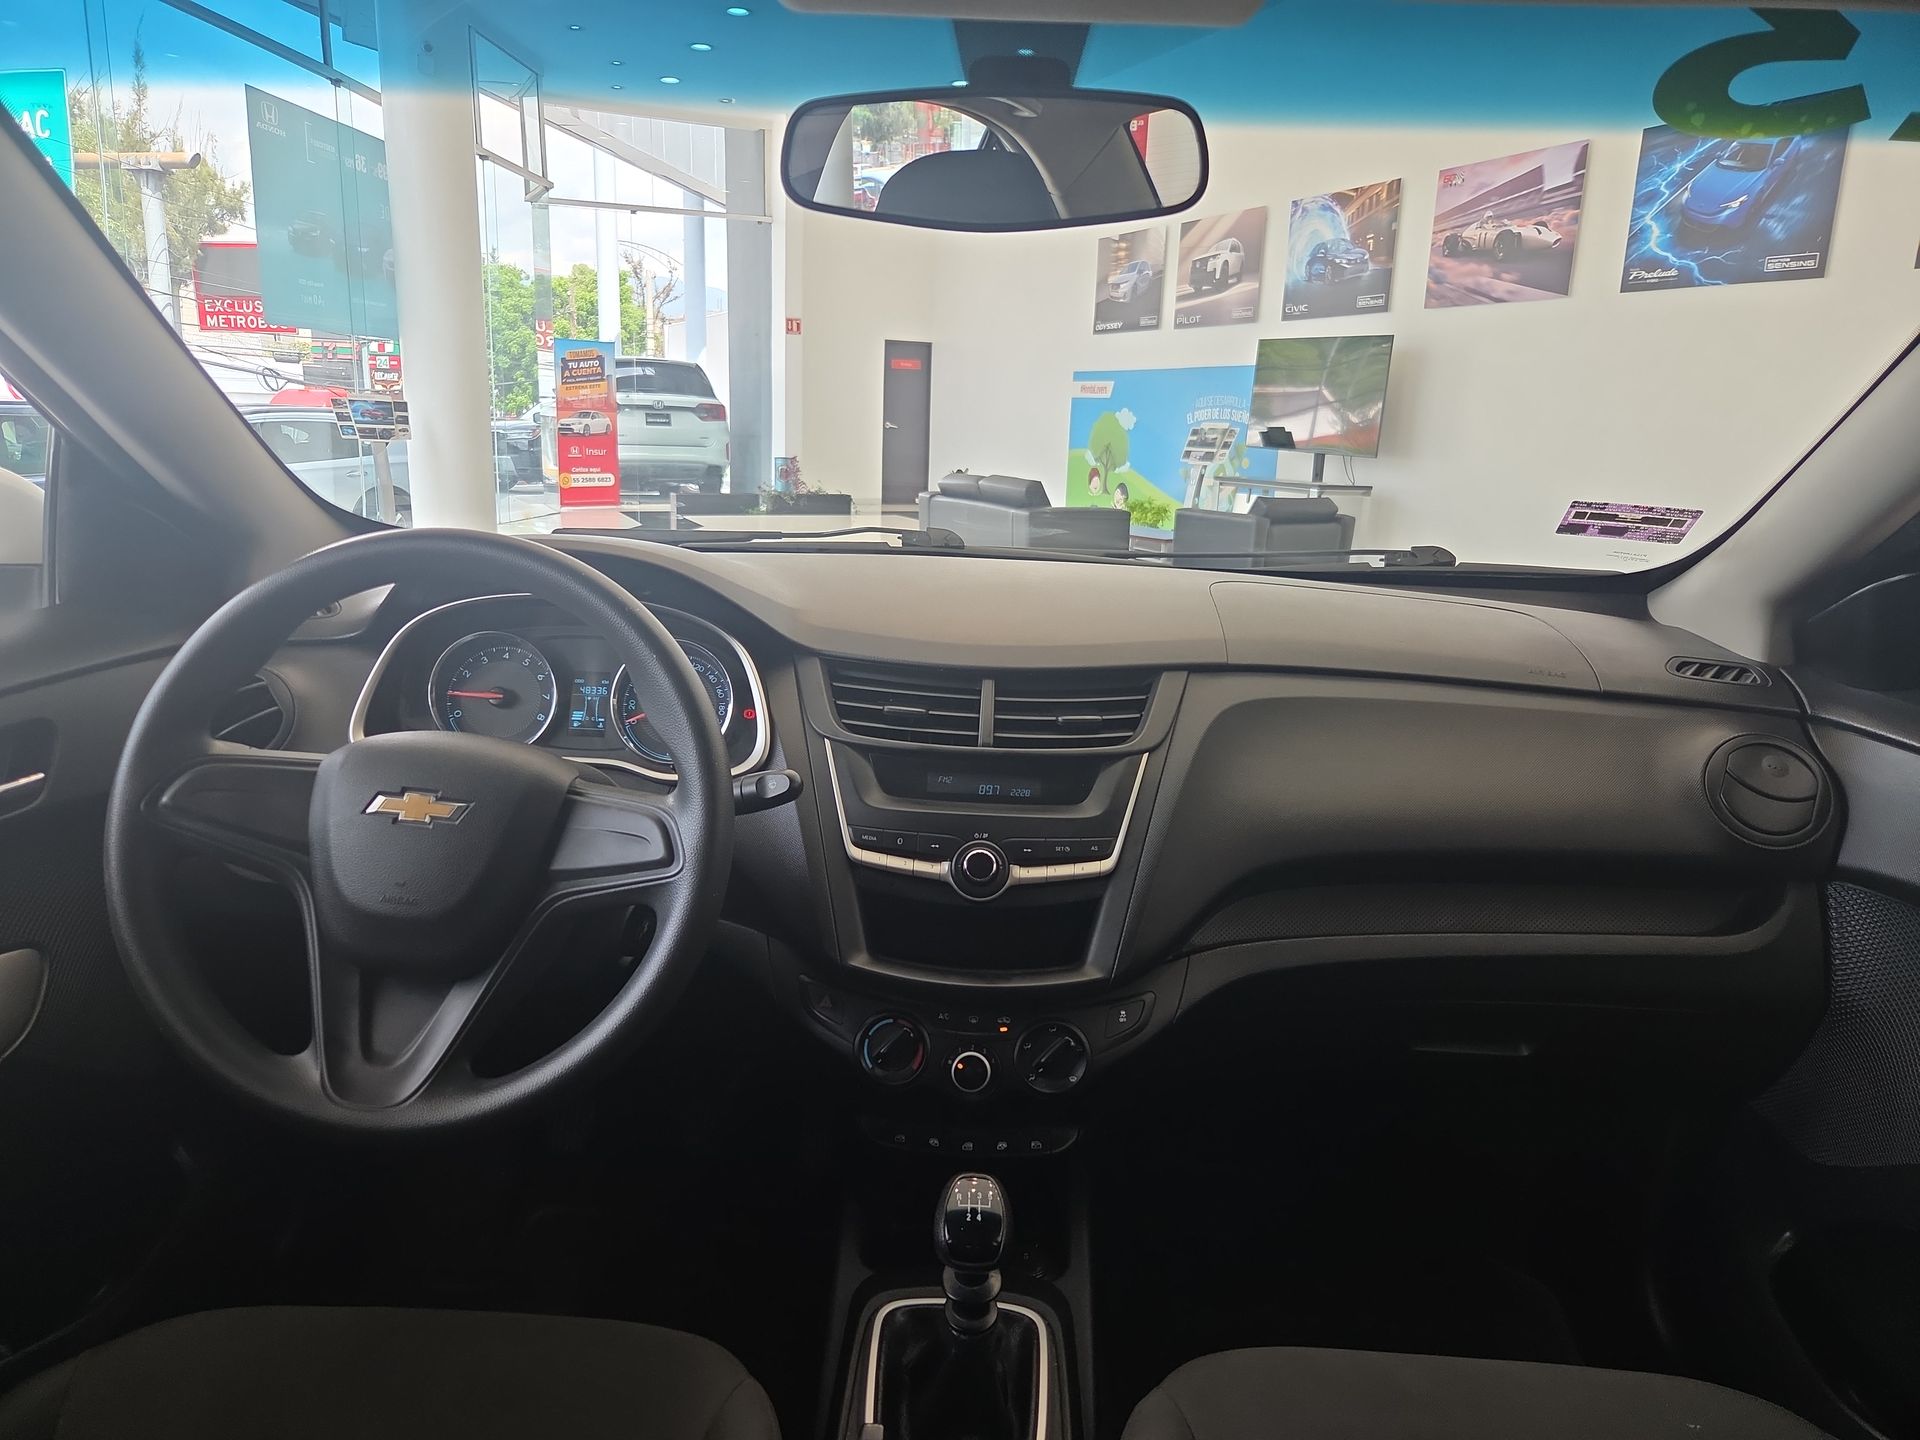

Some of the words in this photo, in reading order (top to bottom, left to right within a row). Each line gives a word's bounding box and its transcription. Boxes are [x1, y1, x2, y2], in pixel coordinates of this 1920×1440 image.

[1767, 260, 1815, 270] SENSING
[1628, 268, 1680, 281] Prelude
[204, 299, 264, 313] EXCLUS
[1285, 304, 1309, 313] CIVIC
[1176, 315, 1201, 325] PILOT
[1095, 322, 1124, 331] ODYSSEY
[377, 358, 389, 368] 24
[579, 360, 600, 368] AUTO
[563, 371, 571, 379] A
[571, 367, 603, 376] CUENTA
[1187, 413, 1193, 425] EL
[1194, 408, 1211, 422] PODER
[1212, 408, 1220, 420] DE
[1220, 408, 1231, 420] LOS
[1231, 409, 1250, 425] SUEÑO
[585, 447, 608, 456] Insur
[480, 655, 489, 665] 3
[502, 652, 510, 660] 4
[522, 658, 531, 667] 5
[462, 669, 472, 679] 2
[537, 673, 546, 681] 6
[705, 671, 718, 684] 140
[580, 686, 608, 695] 48336
[715, 685, 725, 698] 160
[628, 699, 636, 710] 20
[718, 702, 726, 716] 180
[453, 709, 462, 718] 0
[536, 713, 546, 721] 8
[937, 775, 953, 784] FM2
